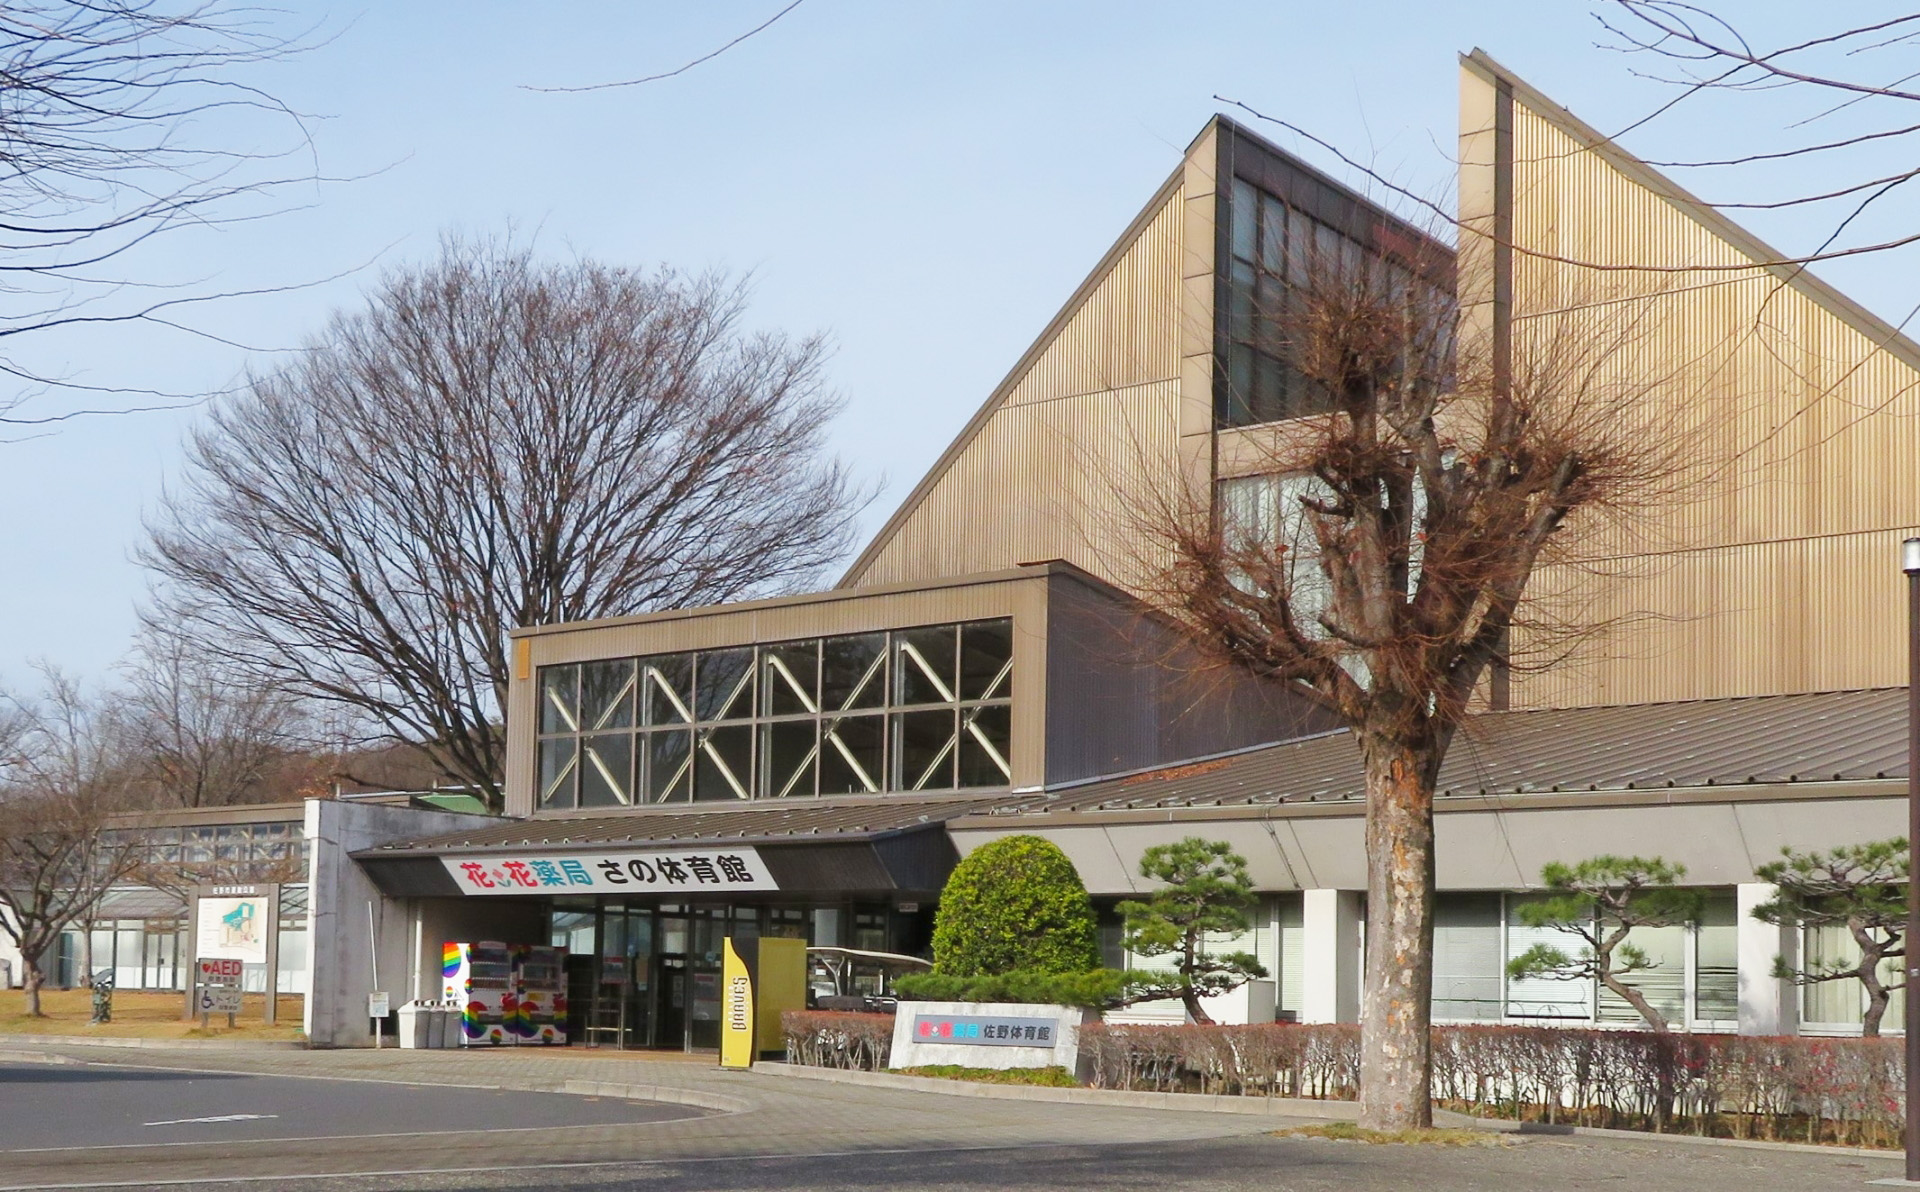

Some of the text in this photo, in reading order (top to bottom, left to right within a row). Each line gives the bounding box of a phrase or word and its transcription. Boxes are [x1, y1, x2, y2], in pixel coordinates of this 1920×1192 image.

[597, 855, 754, 885] さの体育館
[211, 960, 243, 976] AED
[216, 994, 242, 1004] トイレ
[731, 976, 749, 1032] BRAVES
[983, 1024, 1051, 1041] 佐野体育館
